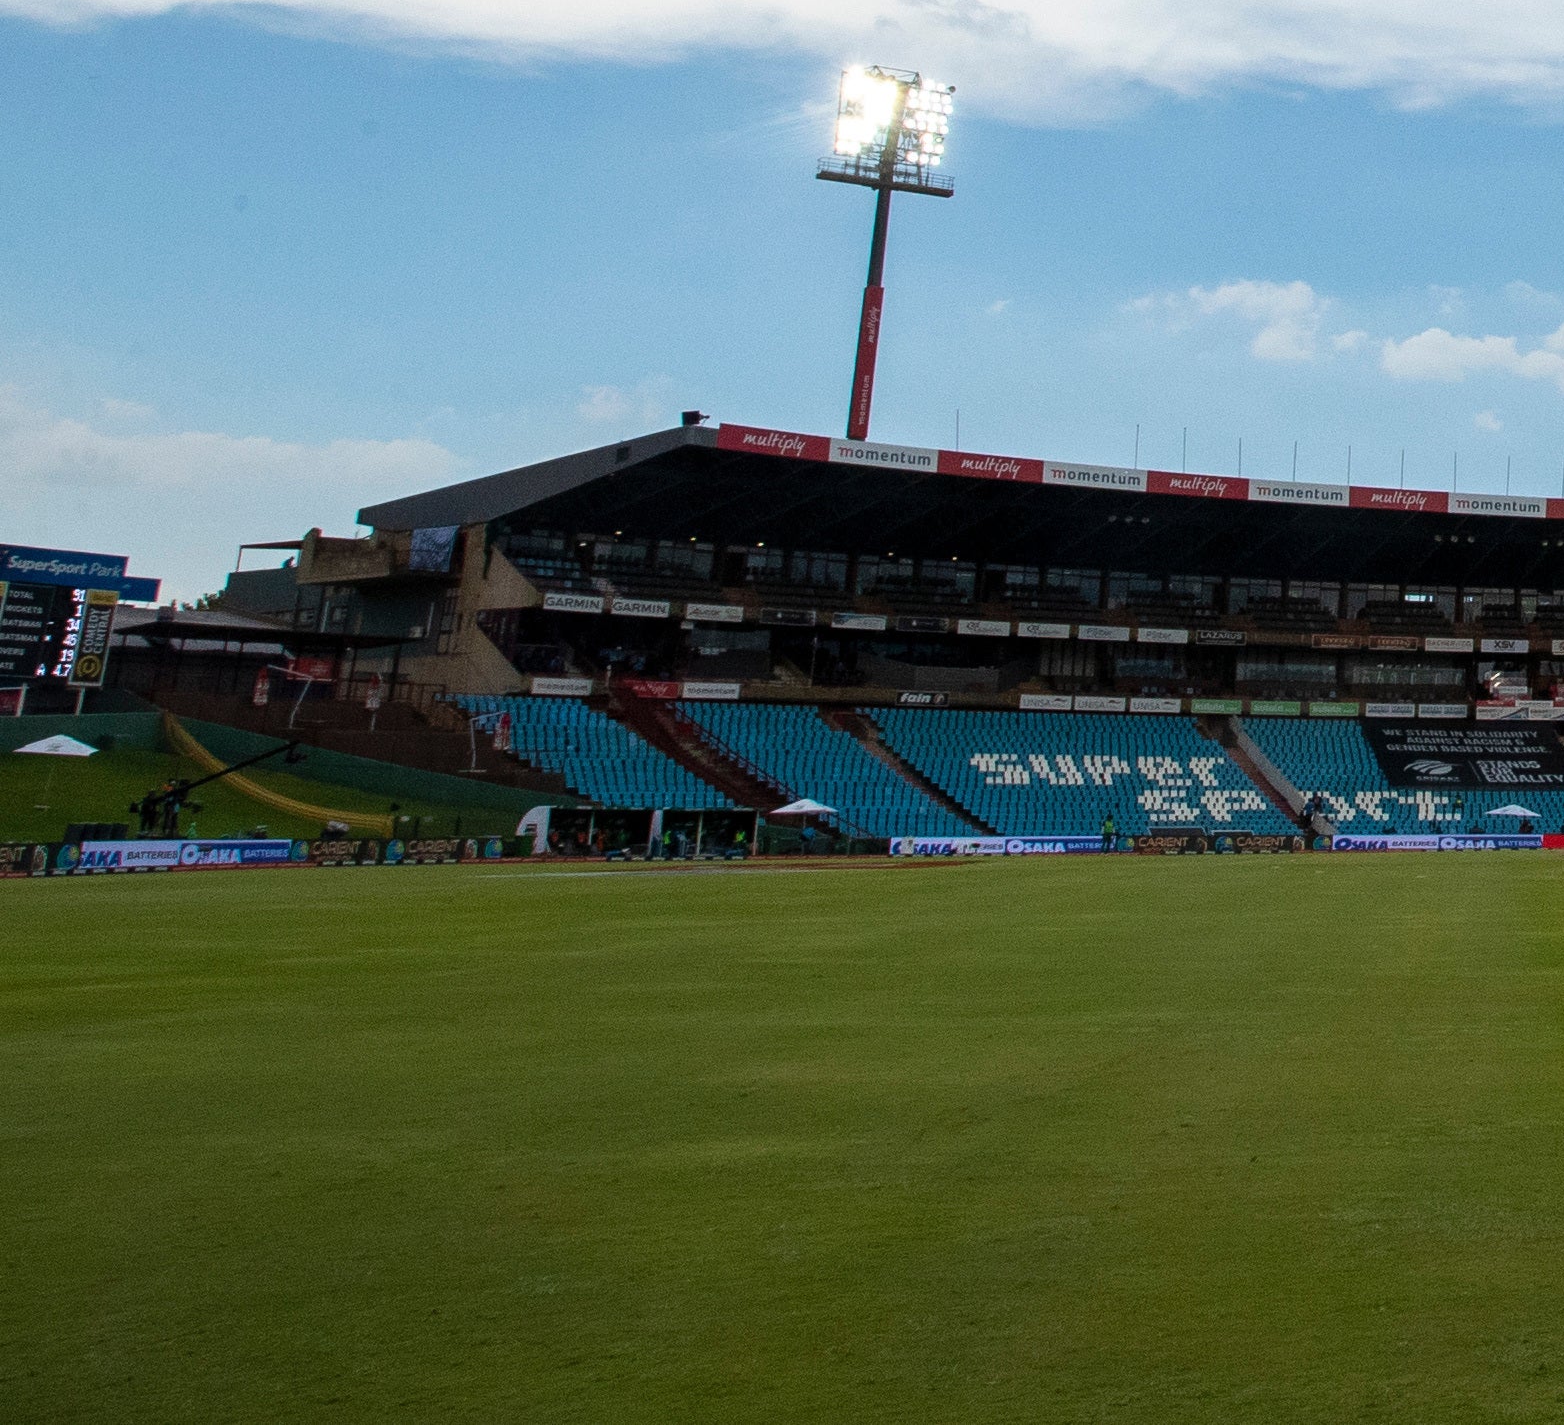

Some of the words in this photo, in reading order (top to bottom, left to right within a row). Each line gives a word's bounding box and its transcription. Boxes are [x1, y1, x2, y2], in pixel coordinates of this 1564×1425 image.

[742, 431, 805, 457] multiply
[837, 446, 931, 466] momentum
[961, 457, 1020, 482] multiply
[1050, 468, 1141, 486] momentum
[1169, 476, 1227, 497] multiply
[1256, 485, 1343, 501] momentum
[1371, 491, 1427, 510] multiply
[1455, 497, 1541, 513] momentum
[8, 555, 87, 575] SuperSport
[89, 563, 122, 577] Park
[545, 597, 602, 609] GARMIN
[613, 602, 667, 615] GARMIN
[1387, 744, 1438, 752] GENDER
[1477, 759, 1541, 769] STANDS
[1487, 774, 1564, 783] EQUALITY
[1006, 839, 1066, 853] OSAKA
[1334, 836, 1388, 851] OSAKA
[1391, 839, 1437, 848] BATTERIES
[1439, 836, 1495, 849] OSAKA
[80, 851, 122, 867] AKA
[127, 851, 177, 861] BATTERIES
